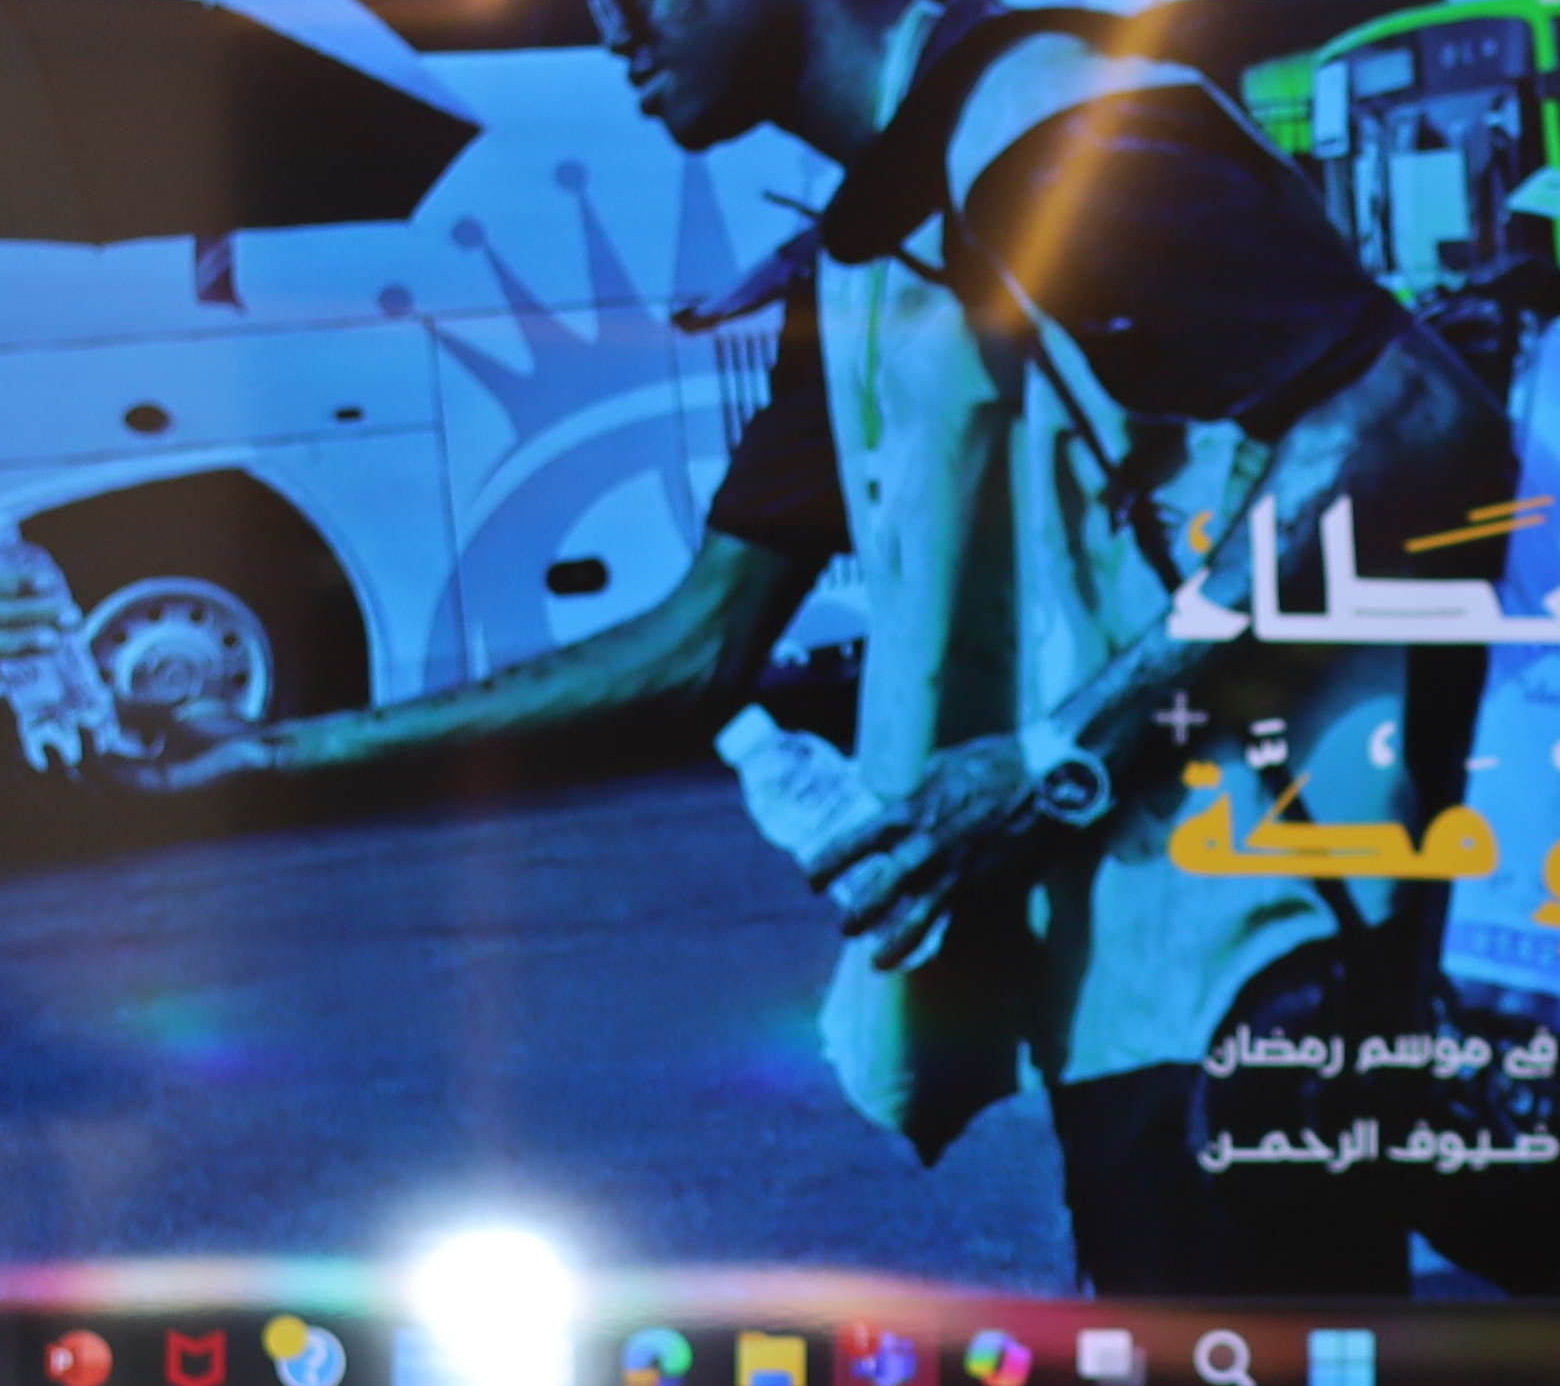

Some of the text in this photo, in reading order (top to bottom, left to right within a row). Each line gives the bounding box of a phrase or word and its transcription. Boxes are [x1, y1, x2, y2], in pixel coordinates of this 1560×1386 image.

[1202, 1023, 1347, 1079] رمضان
[1354, 1030, 1493, 1079] موسم
[1501, 1026, 1560, 1080] في
[1196, 1118, 1381, 1174] الرحمن
